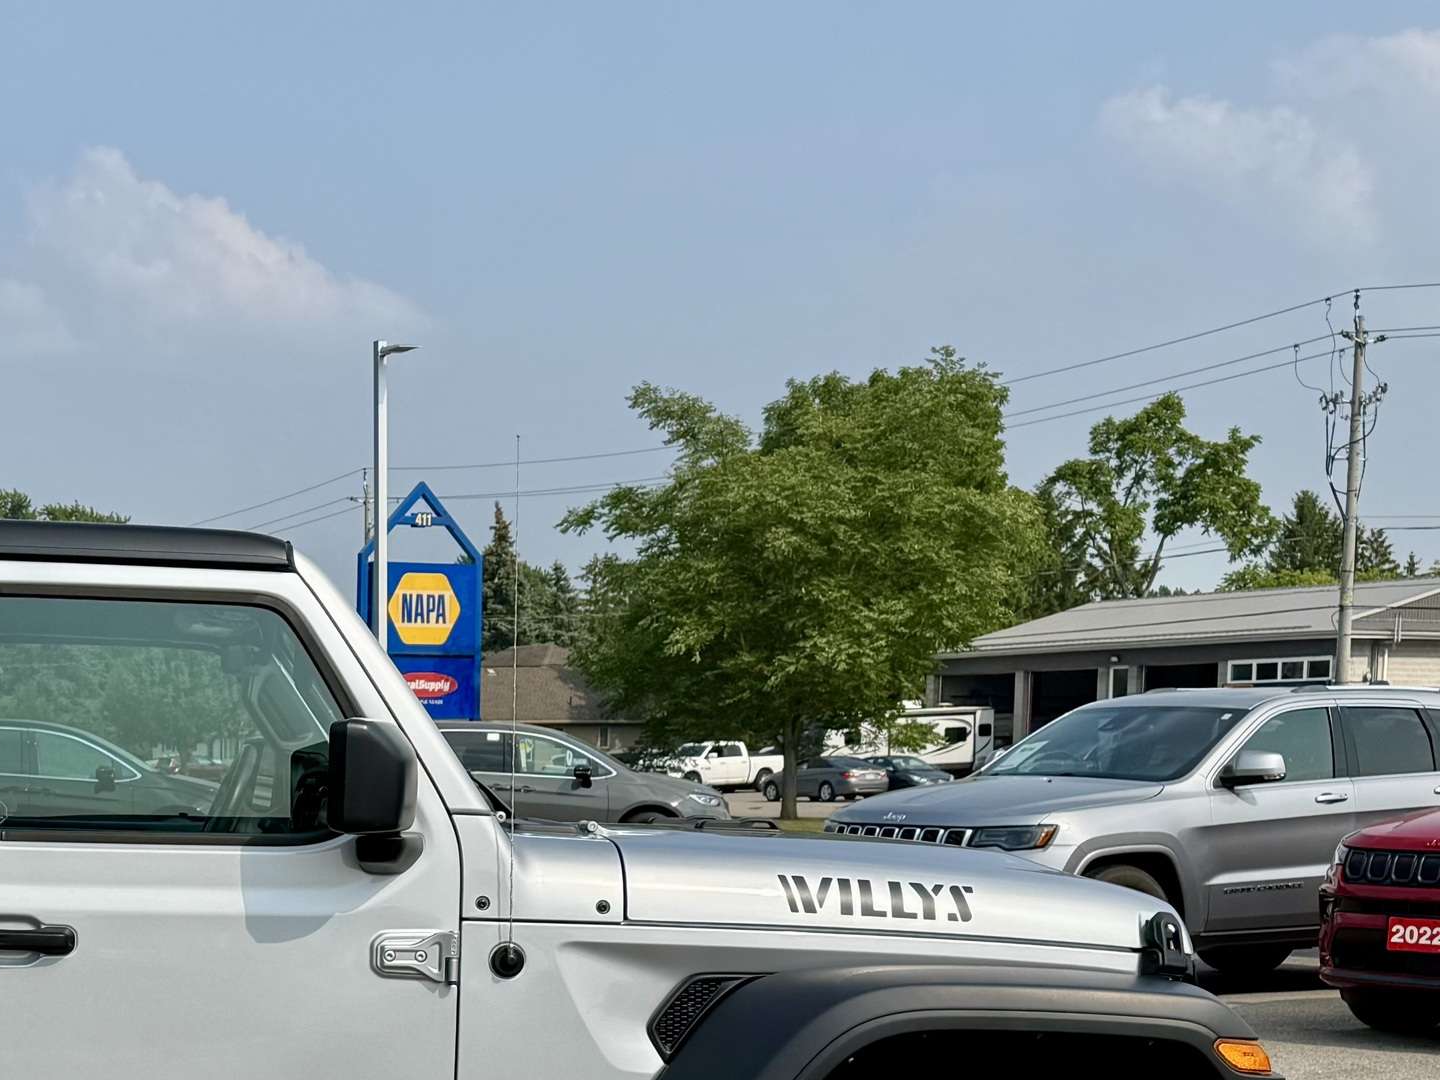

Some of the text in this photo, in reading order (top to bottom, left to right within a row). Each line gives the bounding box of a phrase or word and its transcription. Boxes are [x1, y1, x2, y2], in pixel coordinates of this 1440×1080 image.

[415, 513, 432, 526] 411
[401, 593, 447, 624] NAPA
[777, 874, 974, 922] WILLYS
[1390, 924, 1440, 946] 2022
